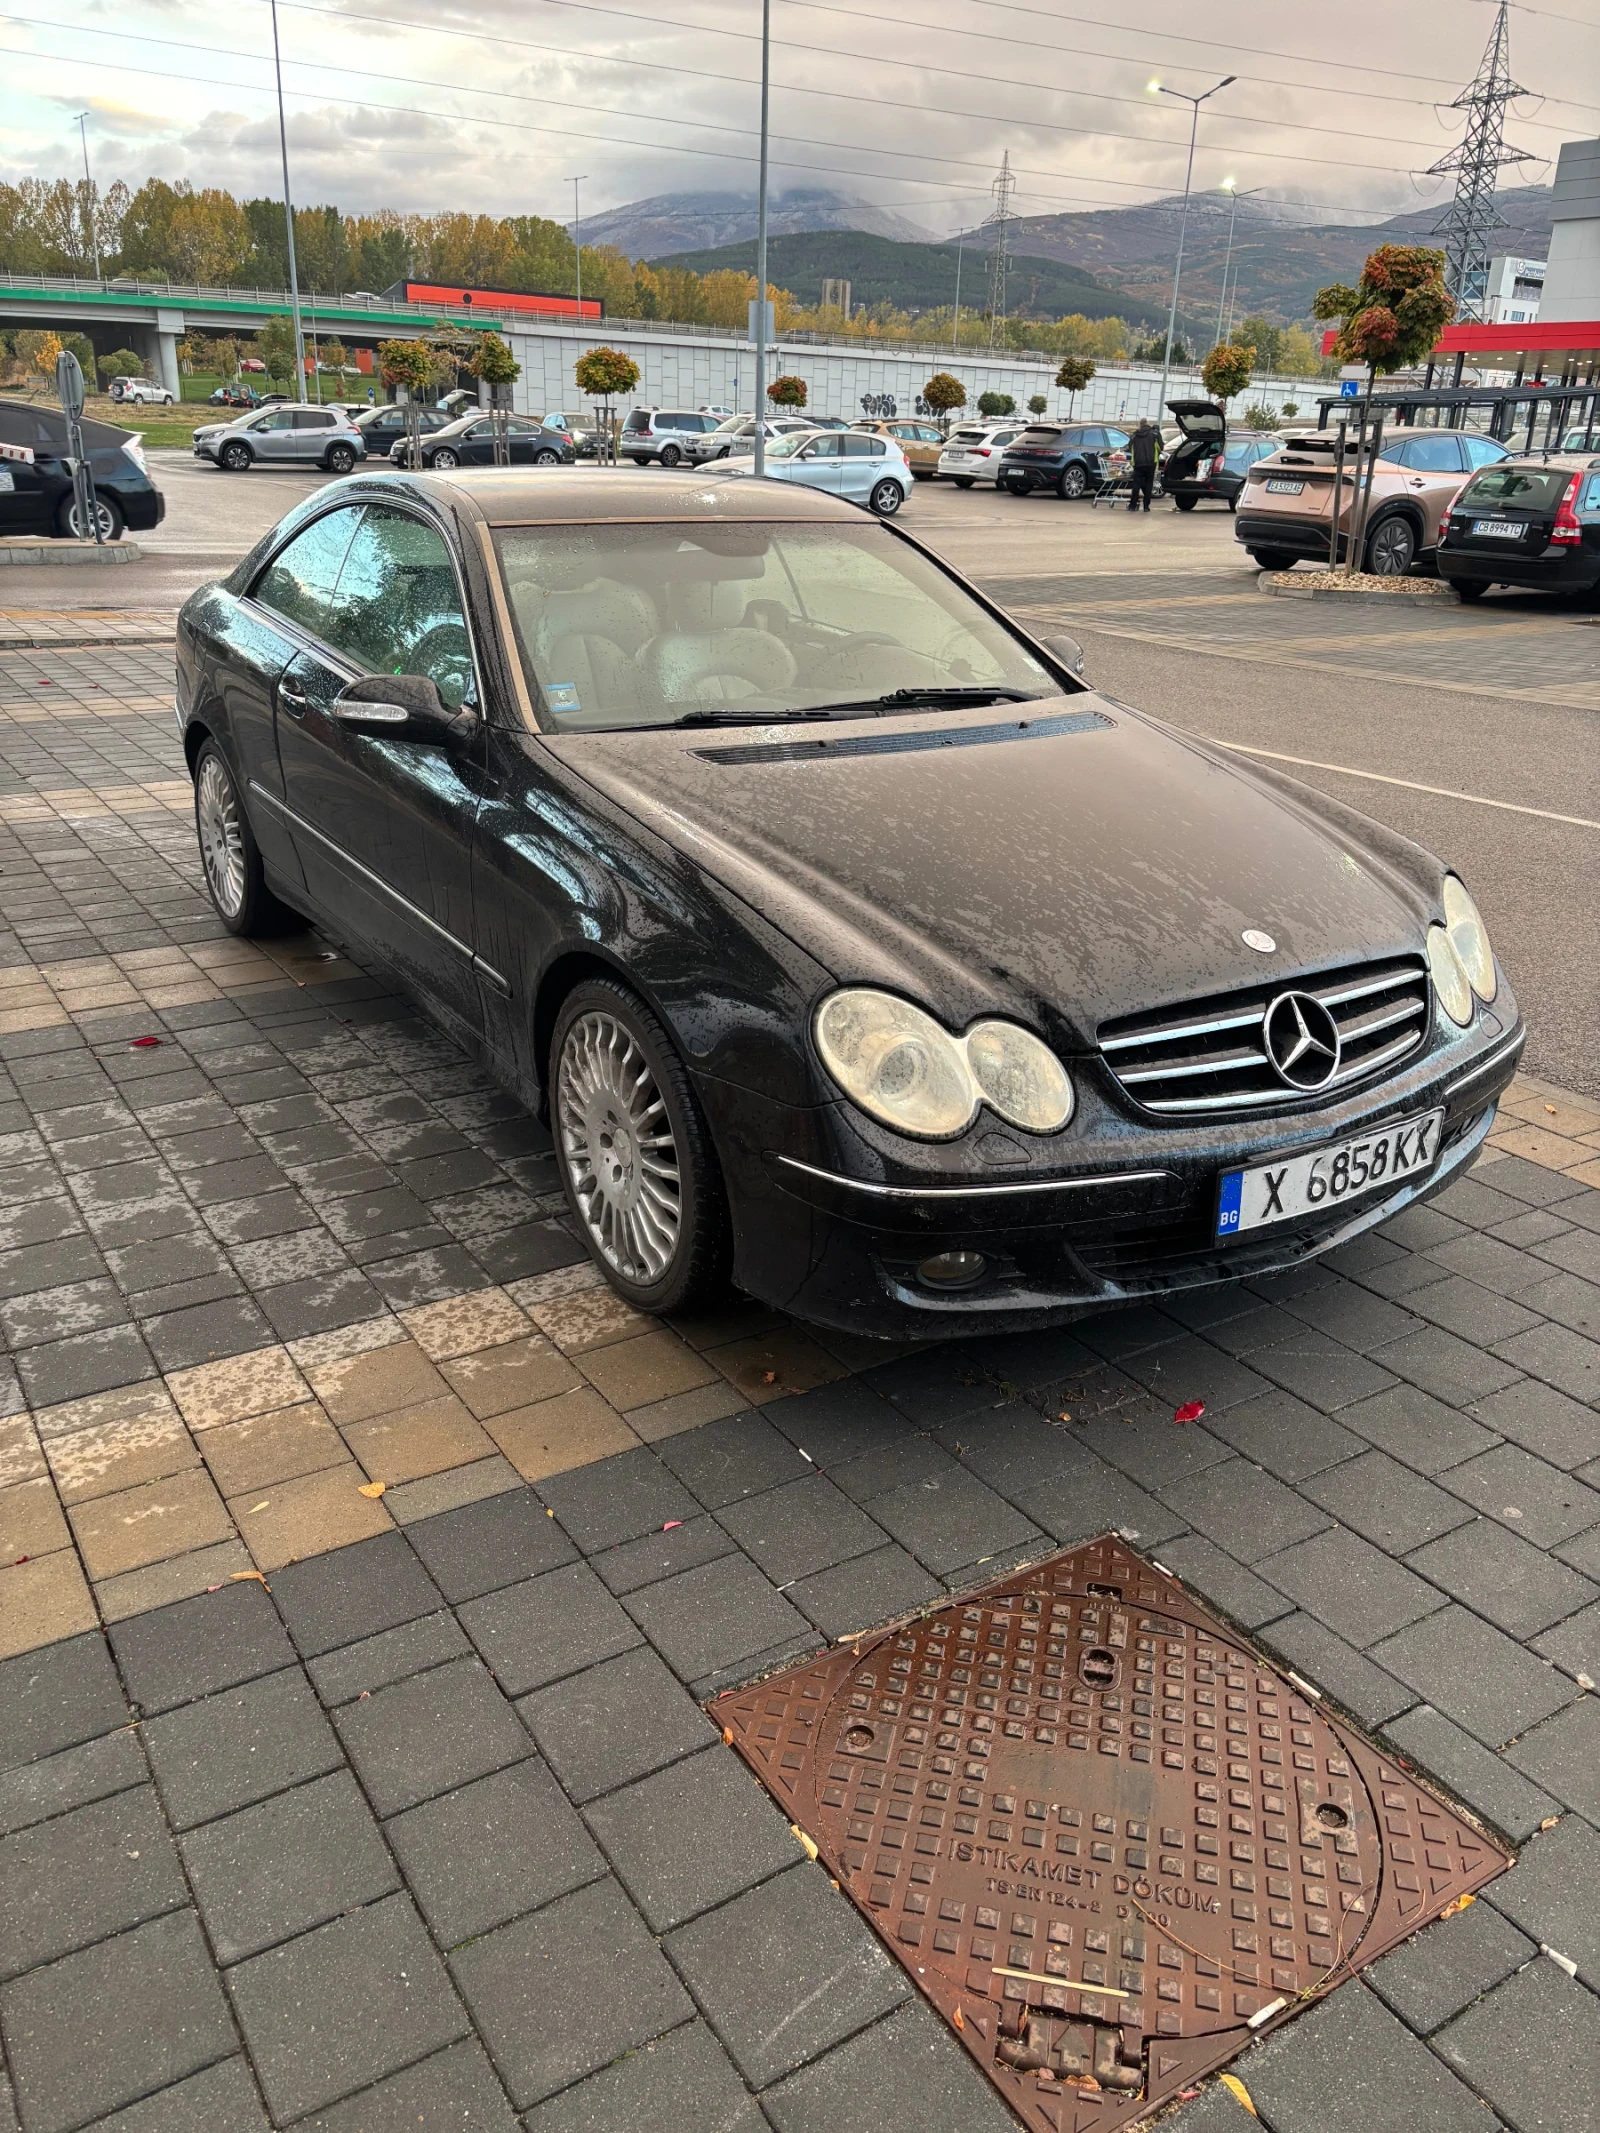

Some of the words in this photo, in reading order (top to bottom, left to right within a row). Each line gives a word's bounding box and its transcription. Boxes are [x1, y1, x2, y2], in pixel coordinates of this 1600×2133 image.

[1478, 522, 1489, 531] CB
[1489, 523, 1508, 533] 8994
[1510, 525, 1520, 534] TC
[1261, 1166, 1289, 1218] X
[1220, 1210, 1237, 1226] BG
[986, 1877, 1012, 1894] TS
[1017, 1883, 1043, 1901] EN
